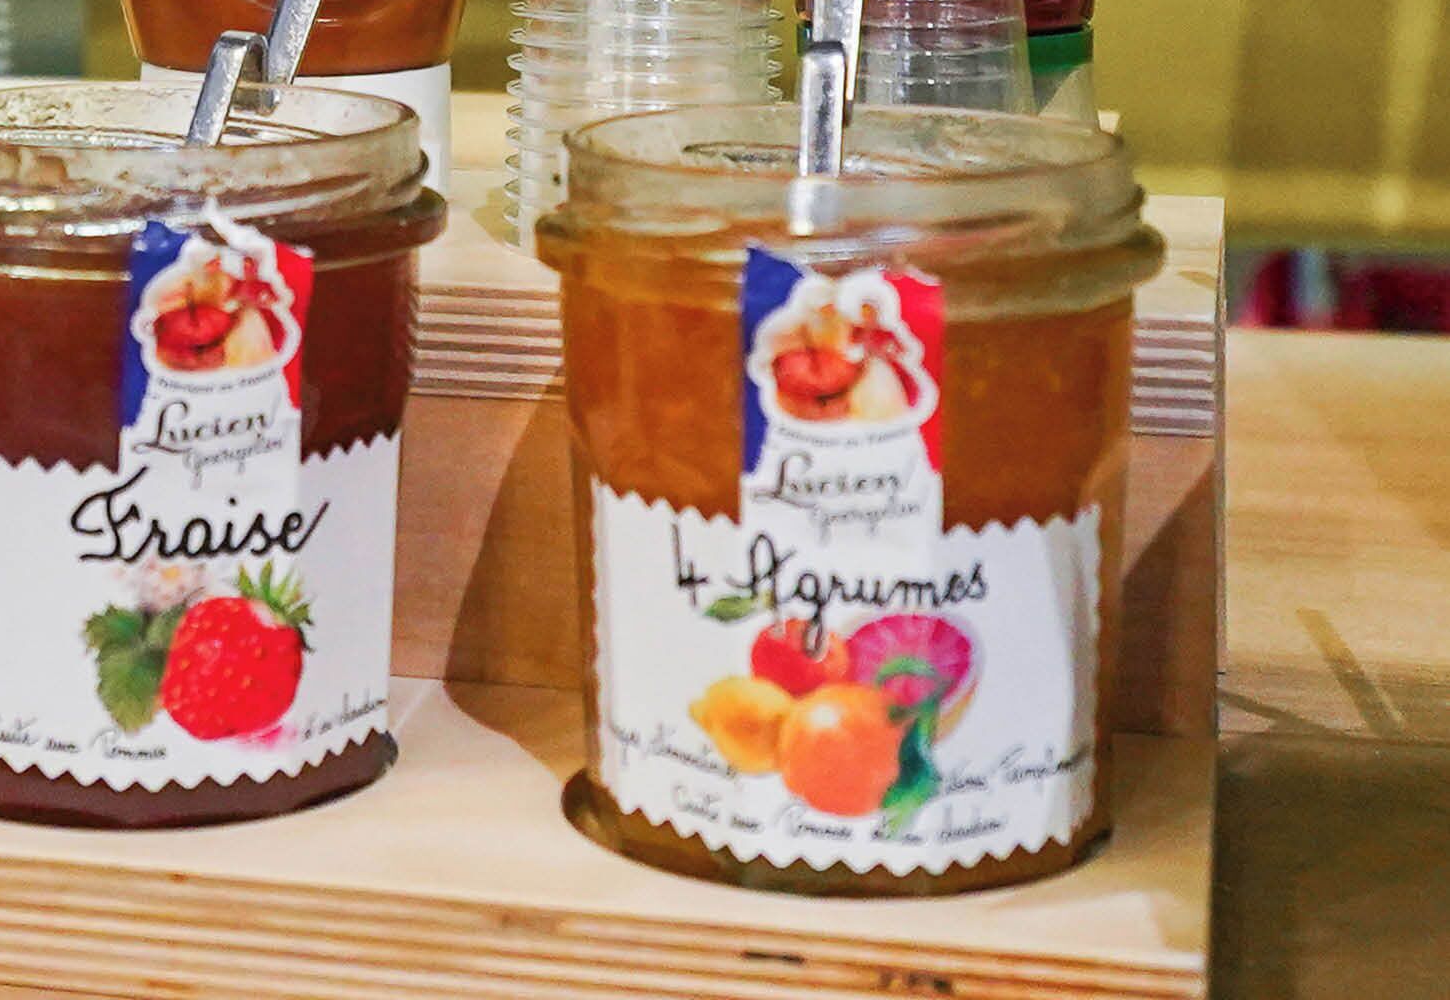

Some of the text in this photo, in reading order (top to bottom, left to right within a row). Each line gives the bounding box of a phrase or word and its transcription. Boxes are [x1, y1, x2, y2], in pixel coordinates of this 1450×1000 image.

[70, 466, 330, 564] Fraise
[672, 522, 989, 659] 4 Agrumes
